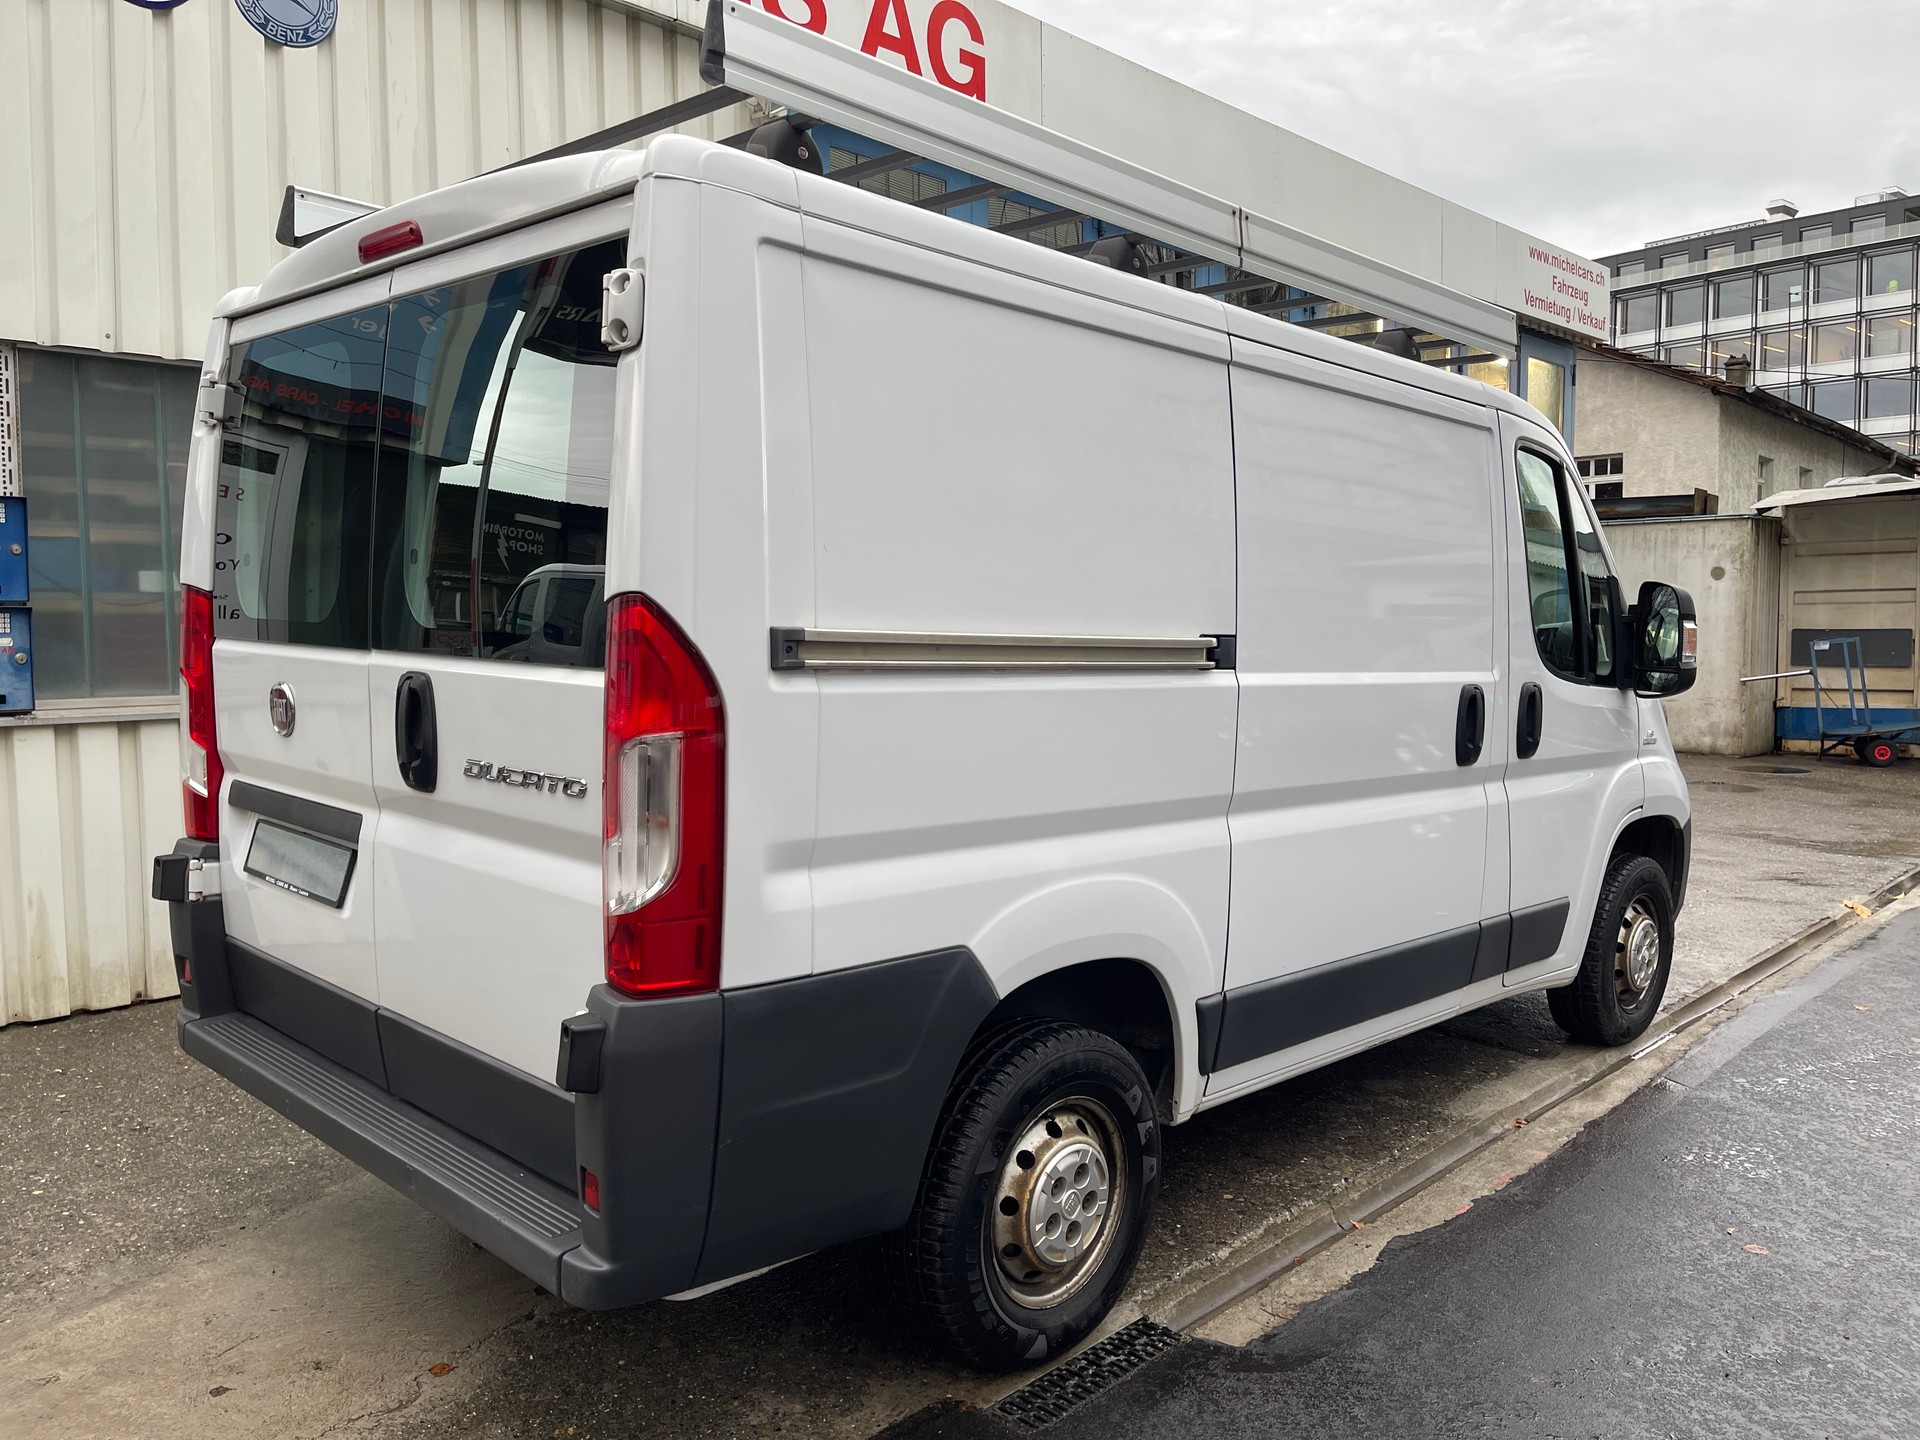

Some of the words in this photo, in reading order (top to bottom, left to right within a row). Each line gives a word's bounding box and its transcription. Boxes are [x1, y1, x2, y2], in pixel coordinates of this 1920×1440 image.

[266, 21, 307, 42] BENZ
[860, 0, 986, 103] AG
[1528, 245, 1605, 287] www.michelcars.ch
[1524, 288, 1571, 323] Vermietung
[1577, 306, 1606, 331] Verkauf
[1552, 275, 1588, 306] Fahrzeug
[463, 758, 587, 798] DUCATO
